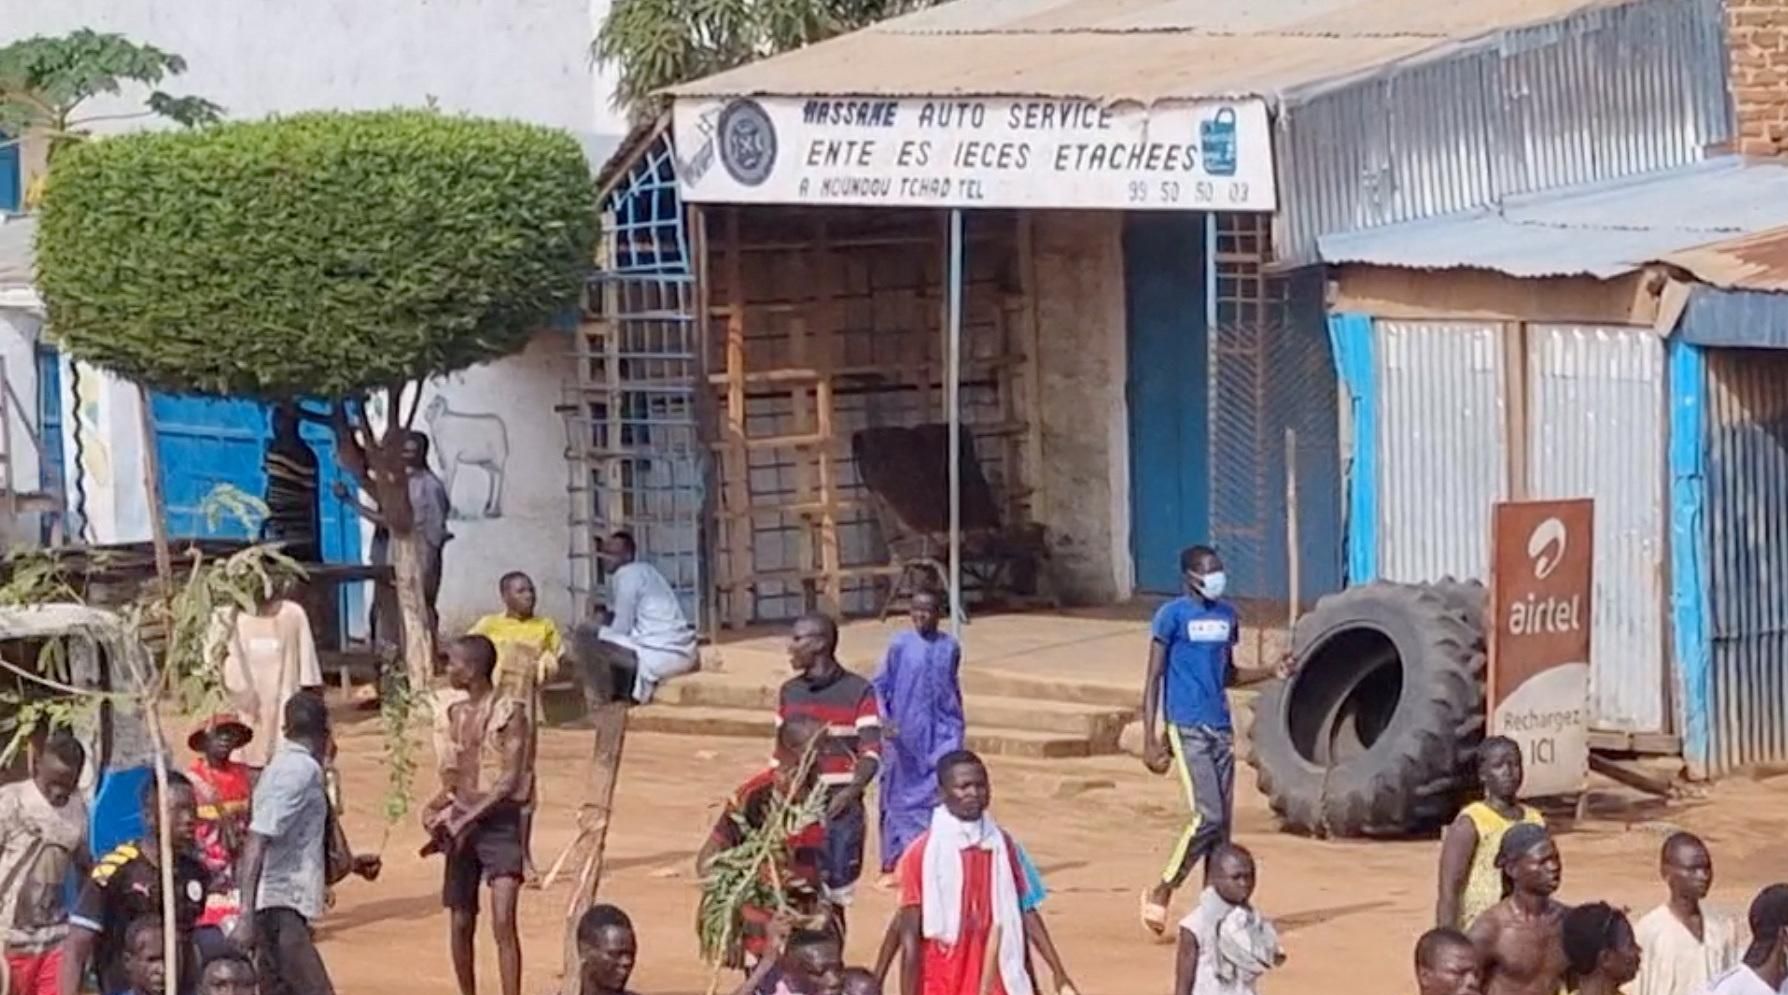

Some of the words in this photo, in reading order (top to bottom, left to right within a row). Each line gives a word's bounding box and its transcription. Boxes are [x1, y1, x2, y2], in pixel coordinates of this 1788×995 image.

[918, 102, 985, 128] AUTO
[1007, 103, 1113, 129] SERVICE
[807, 140, 876, 167] ENTE
[897, 141, 932, 167] ES
[954, 141, 1030, 169] IECES
[1055, 143, 1197, 172] ETACHEES
[900, 178, 951, 198] TCHAD
[959, 179, 984, 199] TEL
[1509, 592, 1580, 635] airtel
[1504, 709, 1581, 733] Rechargez
[1530, 738, 1555, 766] ICI
